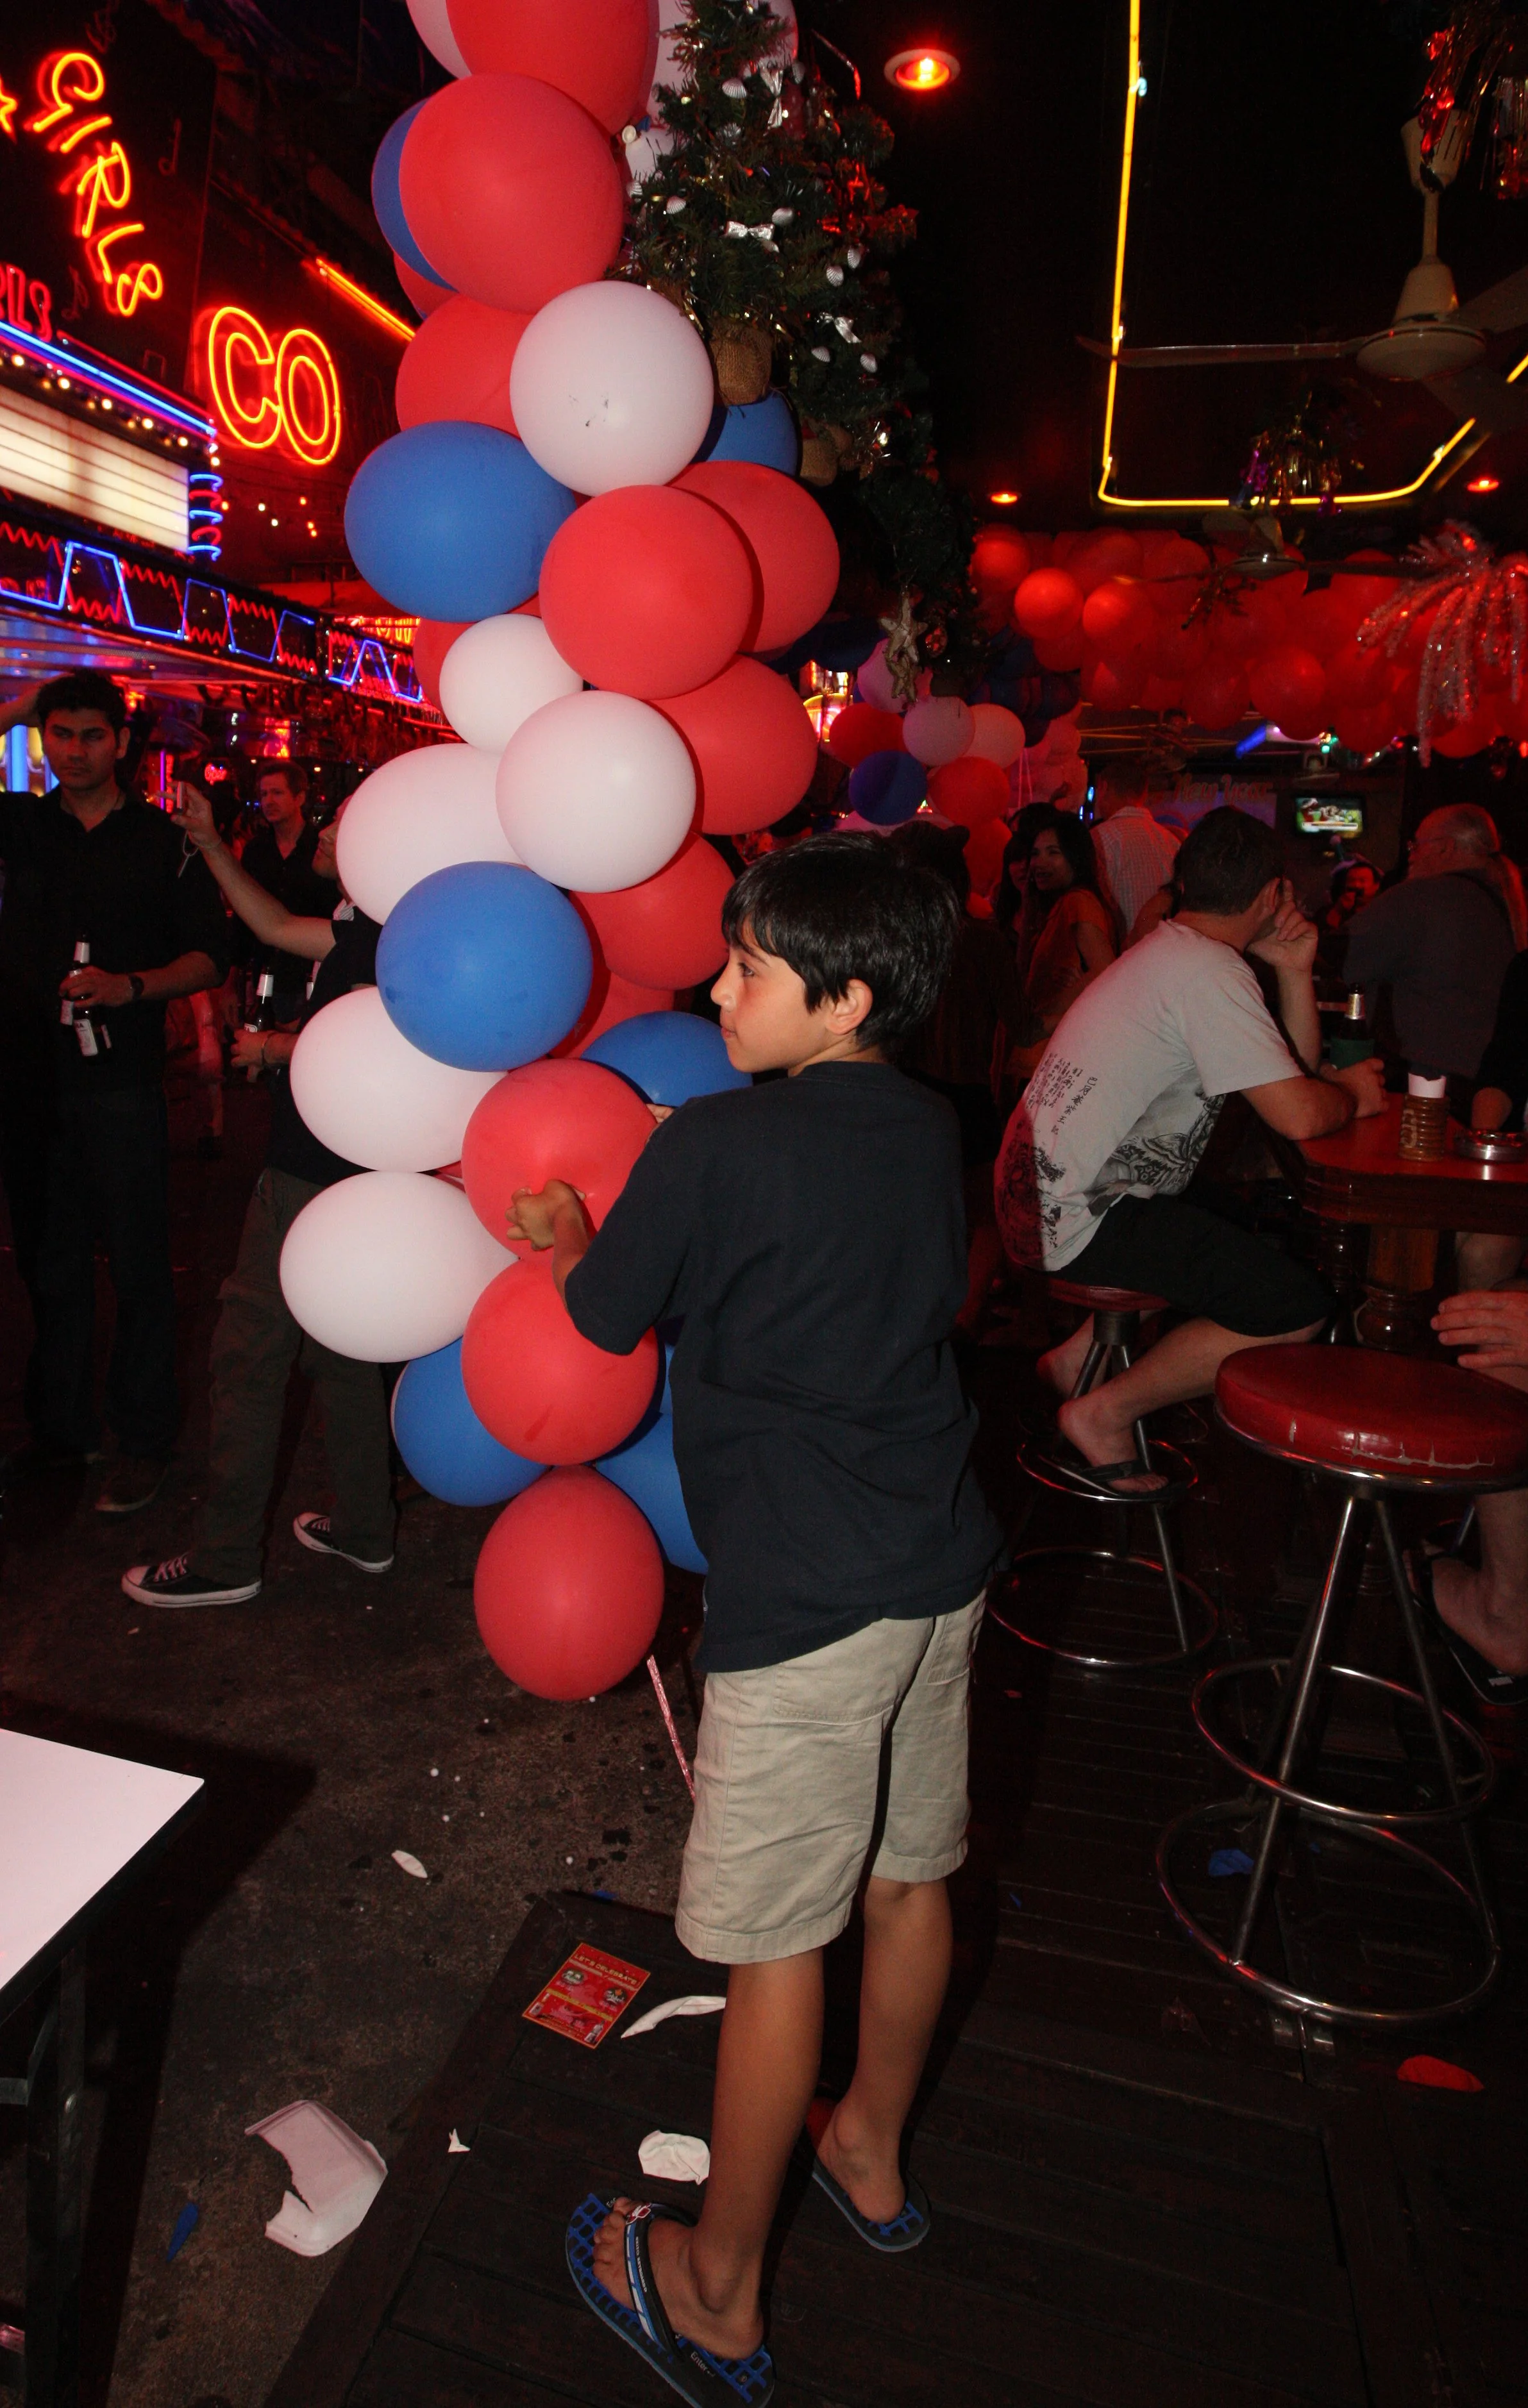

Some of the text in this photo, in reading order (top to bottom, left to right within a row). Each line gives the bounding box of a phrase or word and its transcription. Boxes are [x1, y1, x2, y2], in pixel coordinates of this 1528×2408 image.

[32, 51, 164, 316] GIRLS
[0, 262, 53, 342] LS
[1173, 773, 1273, 804] New Year
[690, 2351, 708, 2371] Enter
